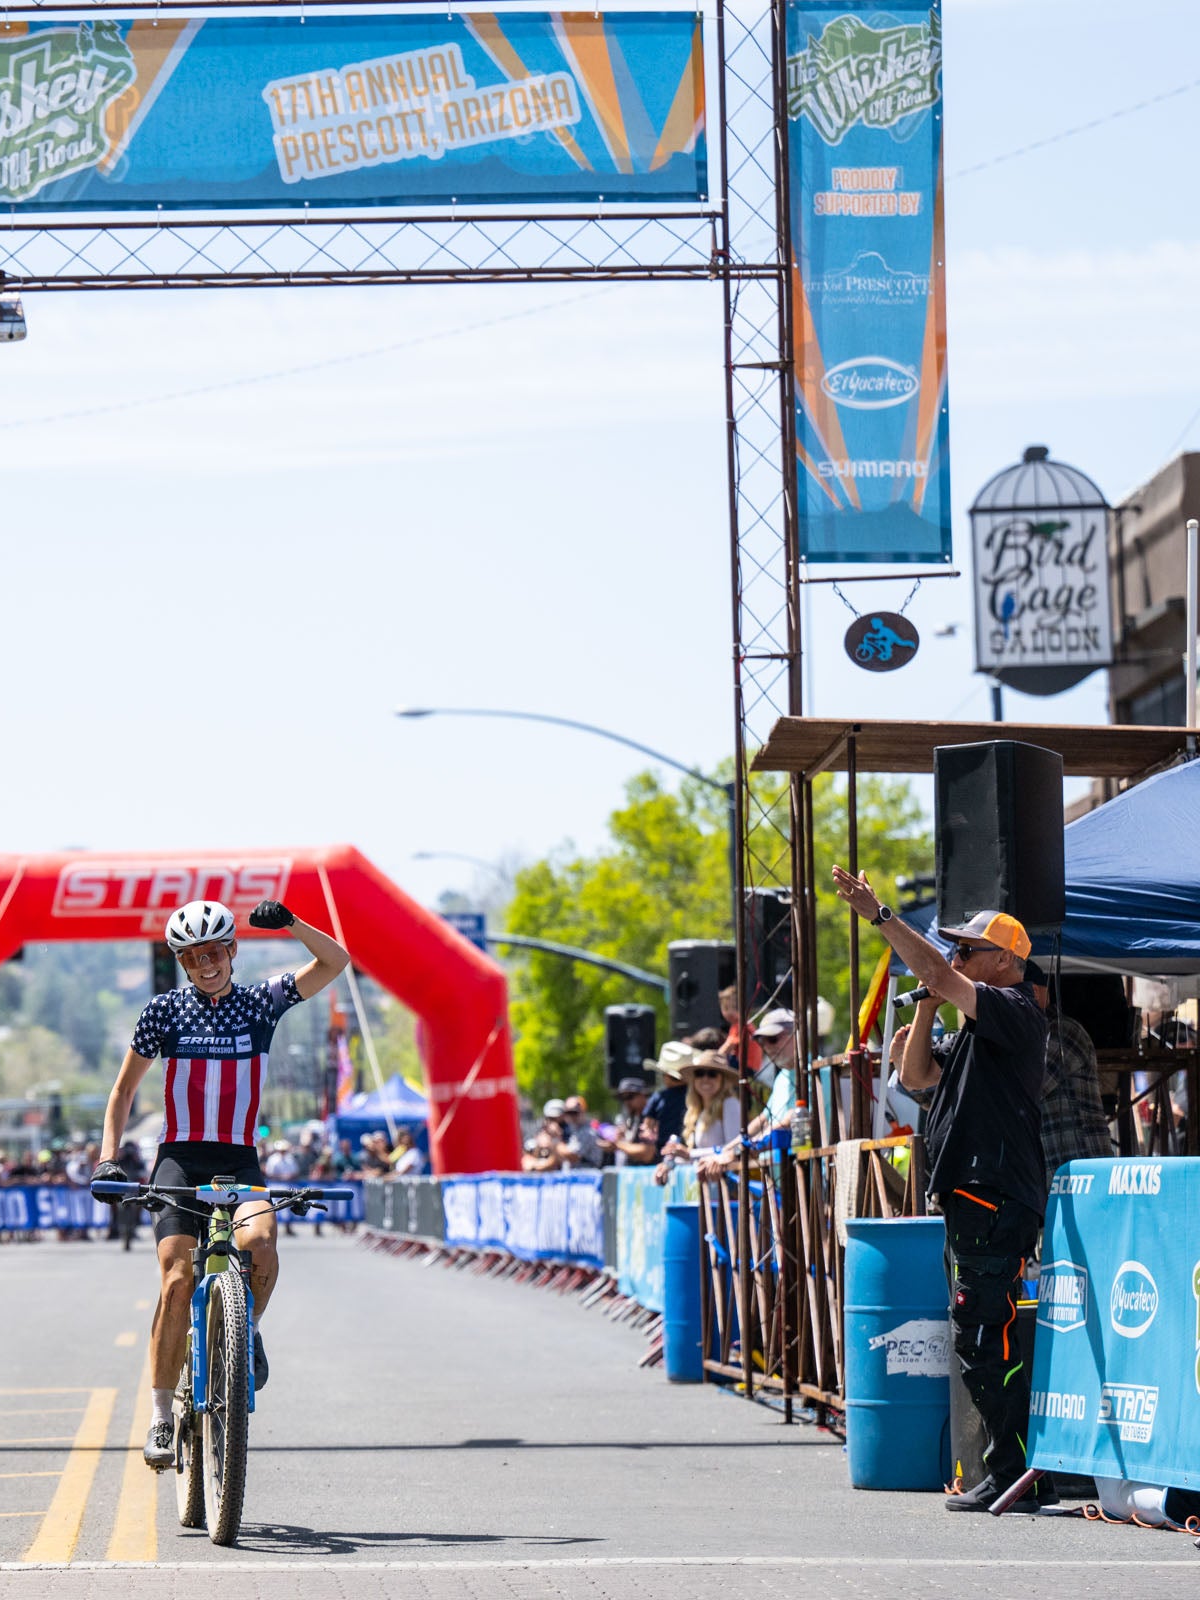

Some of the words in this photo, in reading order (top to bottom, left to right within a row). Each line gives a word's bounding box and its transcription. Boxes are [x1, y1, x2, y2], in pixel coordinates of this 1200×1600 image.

[268, 76, 340, 127] 17TH
[345, 50, 468, 111] ANNUAL
[787, 61, 818, 88] The
[790, 44, 941, 138] Whiskey
[281, 108, 440, 176] PRESCOTT,
[444, 78, 574, 138] ARIZONA
[833, 168, 896, 189] PROUDLY
[814, 193, 896, 215] SUPPORTED
[898, 192, 920, 215] BY
[846, 275, 933, 291] PRESCOTT
[817, 460, 928, 479] SHIMANO
[984, 518, 1098, 574] Bird
[982, 568, 1098, 629] Cage
[989, 625, 1100, 654] SALOON
[177, 1036, 232, 1045] SRAM
[1049, 1174, 1095, 1195] SCOTT
[1108, 1164, 1162, 1195] MAXXIS
[1037, 1275, 1085, 1305] HAMMER
